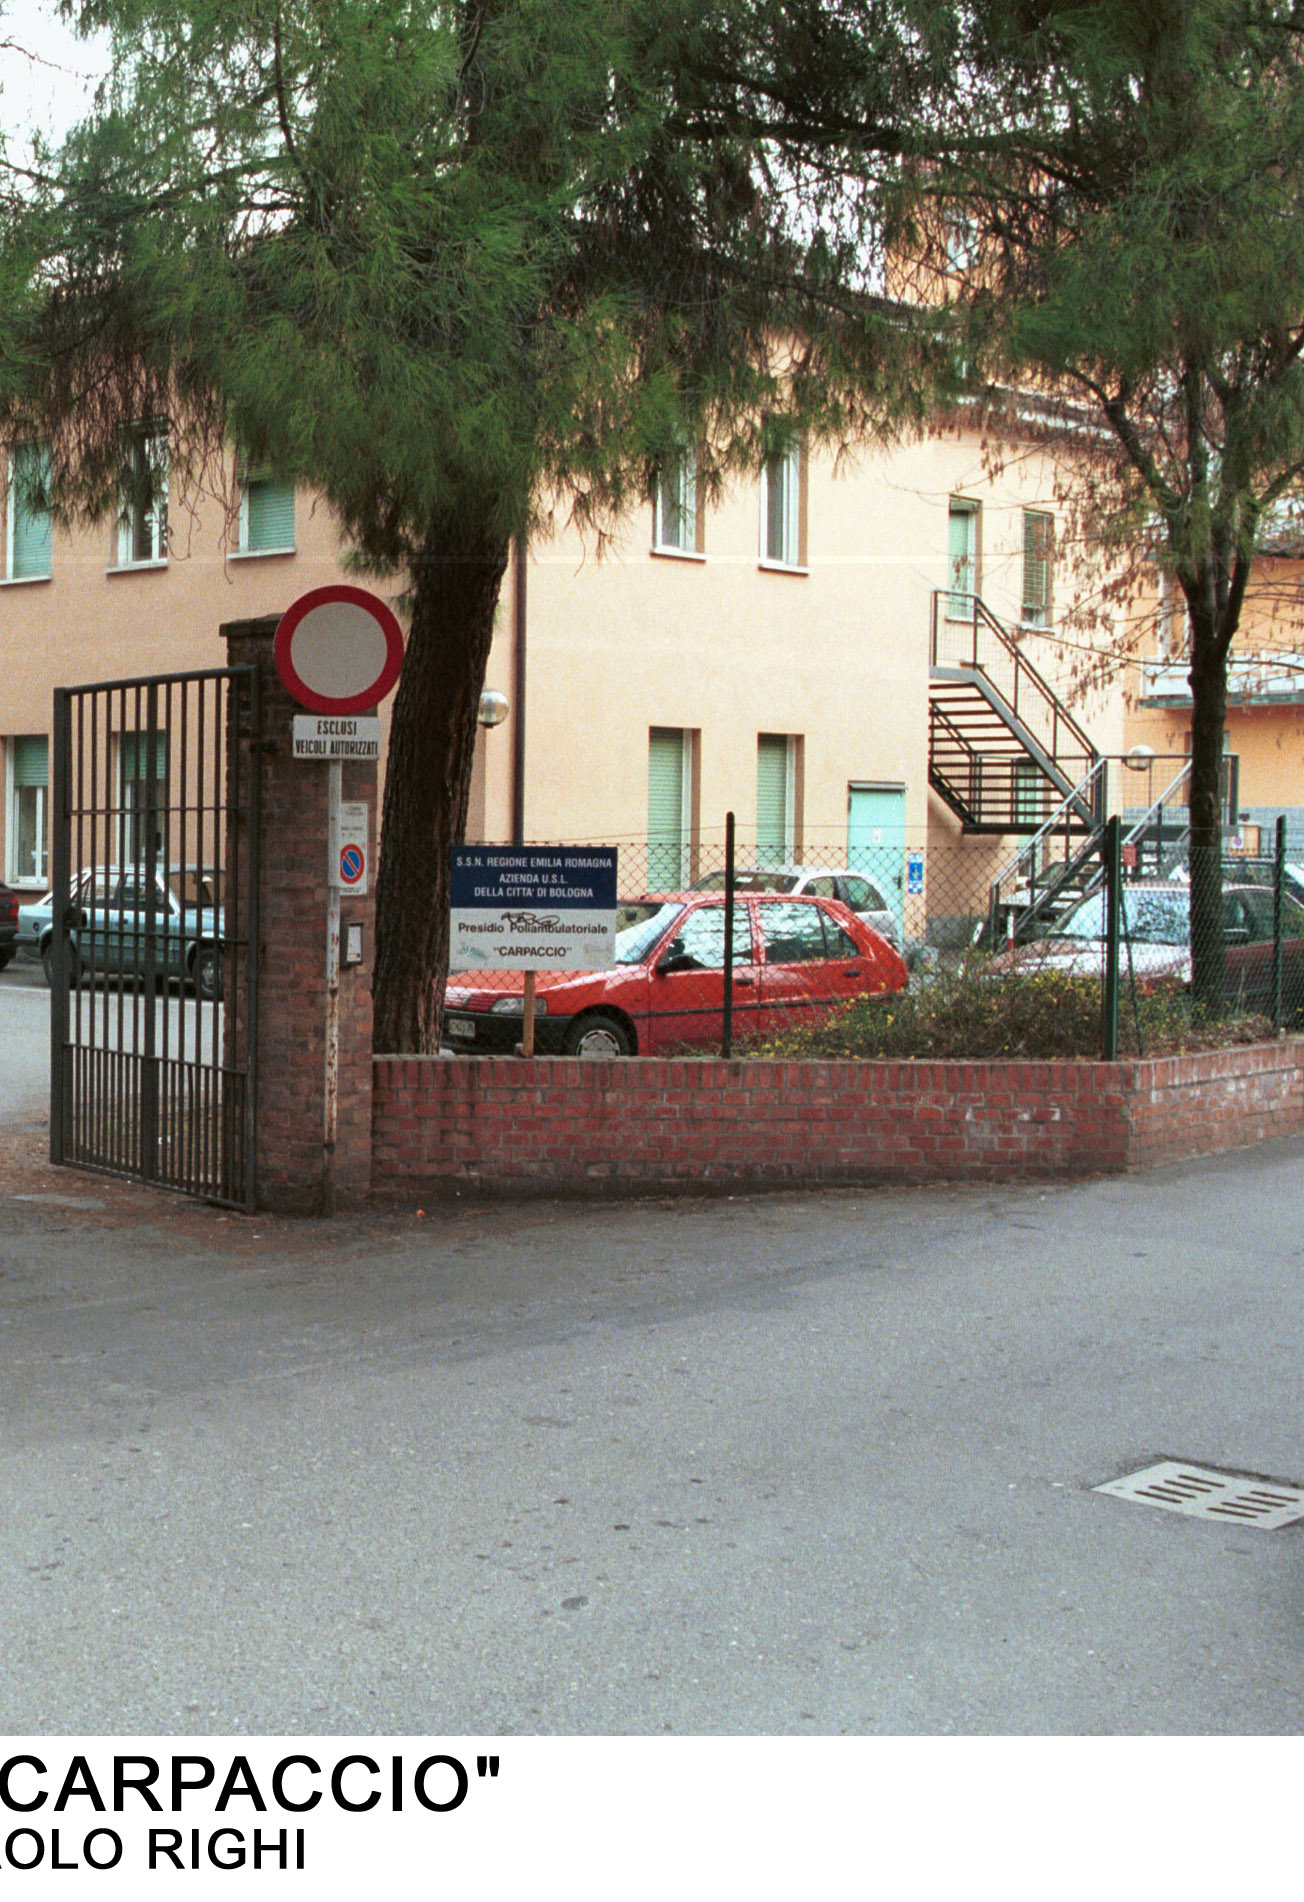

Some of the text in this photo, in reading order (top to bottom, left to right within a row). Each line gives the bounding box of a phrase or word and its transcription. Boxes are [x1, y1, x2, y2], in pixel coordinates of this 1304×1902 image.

[317, 720, 357, 736] ESCLUSI
[295, 739, 378, 755] VEICOLI AUTORIZZATI
[456, 856, 612, 869] S.S.N. REGIONE EMILIA ROMAGNA
[499, 873, 569, 885] AZIENDA U.S.L.
[474, 886, 594, 898] DELLA CITTA' DI BOLOGNA
[458, 922, 608, 934] Presidio Poliambulatoriale
[493, 946, 572, 957] "CARPACCIO"
